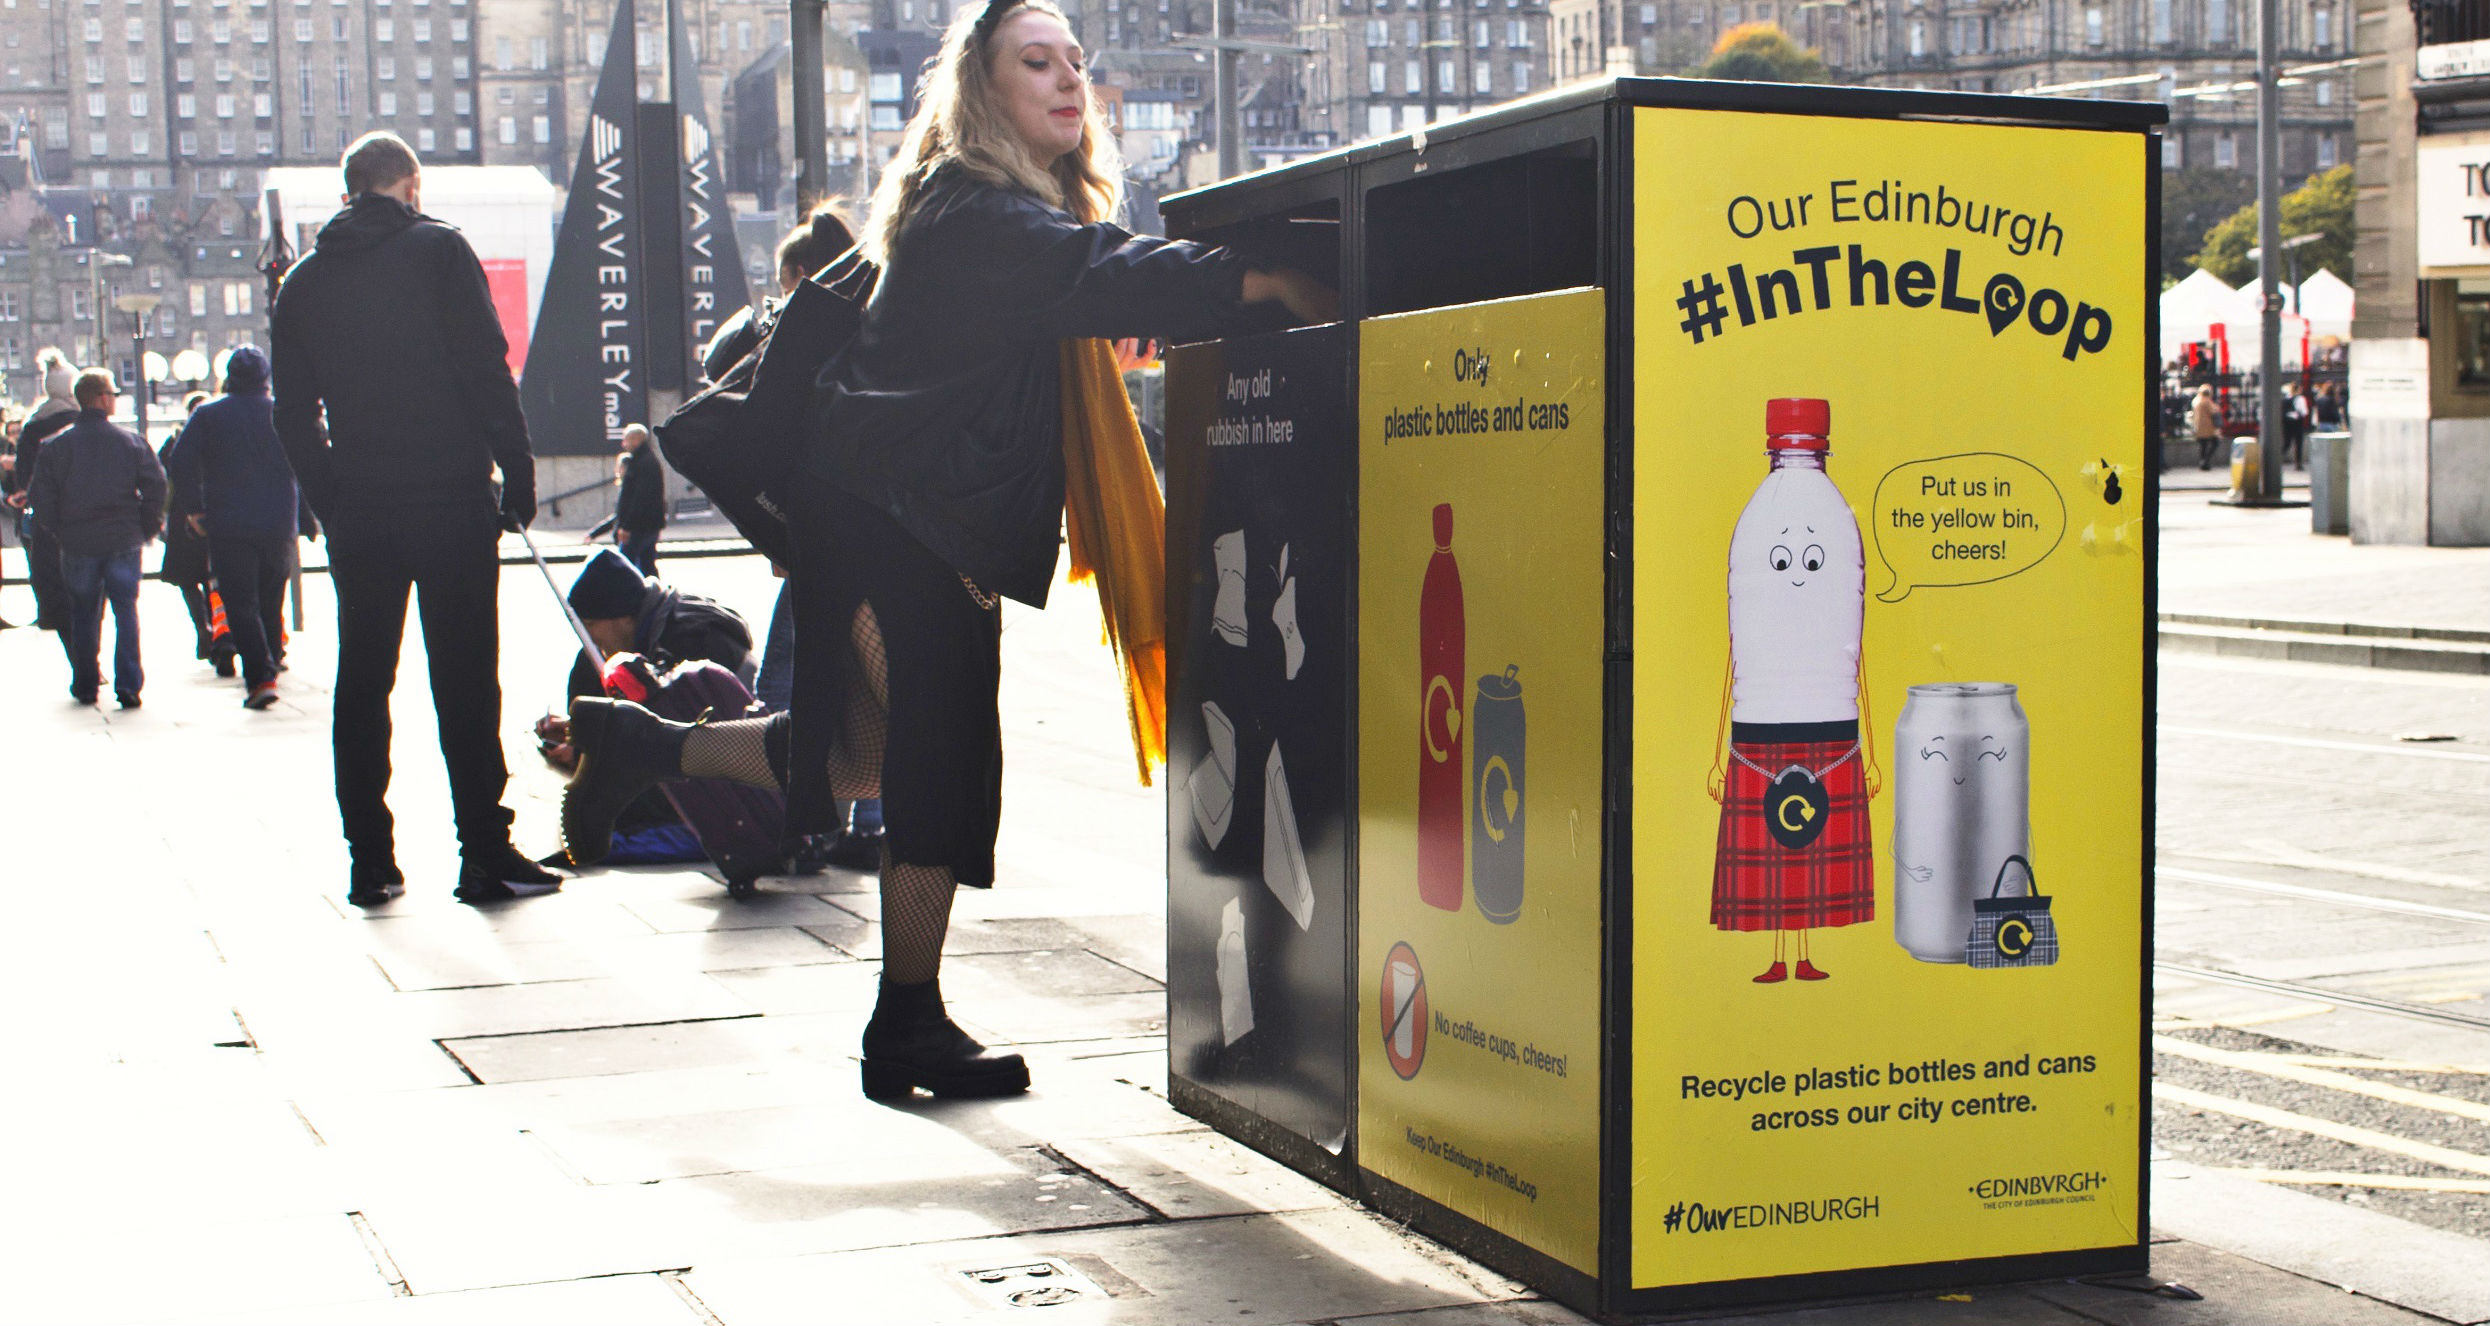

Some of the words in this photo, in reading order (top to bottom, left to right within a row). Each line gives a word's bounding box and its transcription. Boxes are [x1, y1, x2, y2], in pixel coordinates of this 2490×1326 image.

[1727, 193, 1813, 239] Our
[1830, 180, 2064, 257] Edinburgh
[596, 157, 631, 392] WAVERLEY
[1676, 244, 2112, 362] #InTheLoop
[1454, 347, 1490, 387] Only
[1227, 372, 1250, 406] Any
[1252, 369, 1271, 398] old
[604, 392, 624, 440] mall
[1207, 418, 1249, 446] rubbish
[1252, 416, 1263, 444] in
[1266, 415, 1294, 444] here
[1384, 405, 1432, 446] plastic
[1436, 401, 1489, 436] bottles
[1493, 397, 1523, 432] and
[1528, 402, 1569, 431] cans
[1921, 475, 1956, 497] Put
[1963, 480, 1987, 497] us
[1994, 476, 2011, 497] in
[1892, 508, 1924, 528] the
[1931, 508, 1995, 533] yellow
[2002, 508, 2039, 531] bin,
[1931, 540, 2006, 560] cheers!
[1434, 1010, 1450, 1036] No
[1452, 1021, 1486, 1049] coffee
[1488, 1034, 1520, 1065] cups,
[1522, 1042, 1567, 1078] cheers!
[1681, 1070, 1786, 1101] Recycle
[1794, 1063, 1881, 1096] plastic
[1888, 1058, 1977, 1086] bottles
[1983, 1053, 2030, 1080] and
[2036, 1051, 2097, 1075] cans
[1751, 1108, 1839, 1131] across
[1846, 1104, 1891, 1124] our
[1897, 1096, 1944, 1123] city
[1950, 1091, 2038, 1117] centre.
[1406, 1126, 1426, 1152] Keep
[1427, 1135, 1441, 1156] Our
[1443, 1142, 1484, 1178] Edinburgh
[1486, 1161, 1537, 1203] #InTheLoop
[1663, 1196, 1879, 1234] #OurEDINBURGH
[1983, 1202, 1997, 1210] THE
[1998, 1201, 2012, 1209] CITY
[2013, 1200, 2023, 1208] OF
[2024, 1198, 2064, 1206] EDINBURGH
[2065, 1195, 2096, 1204] COUNCIL
